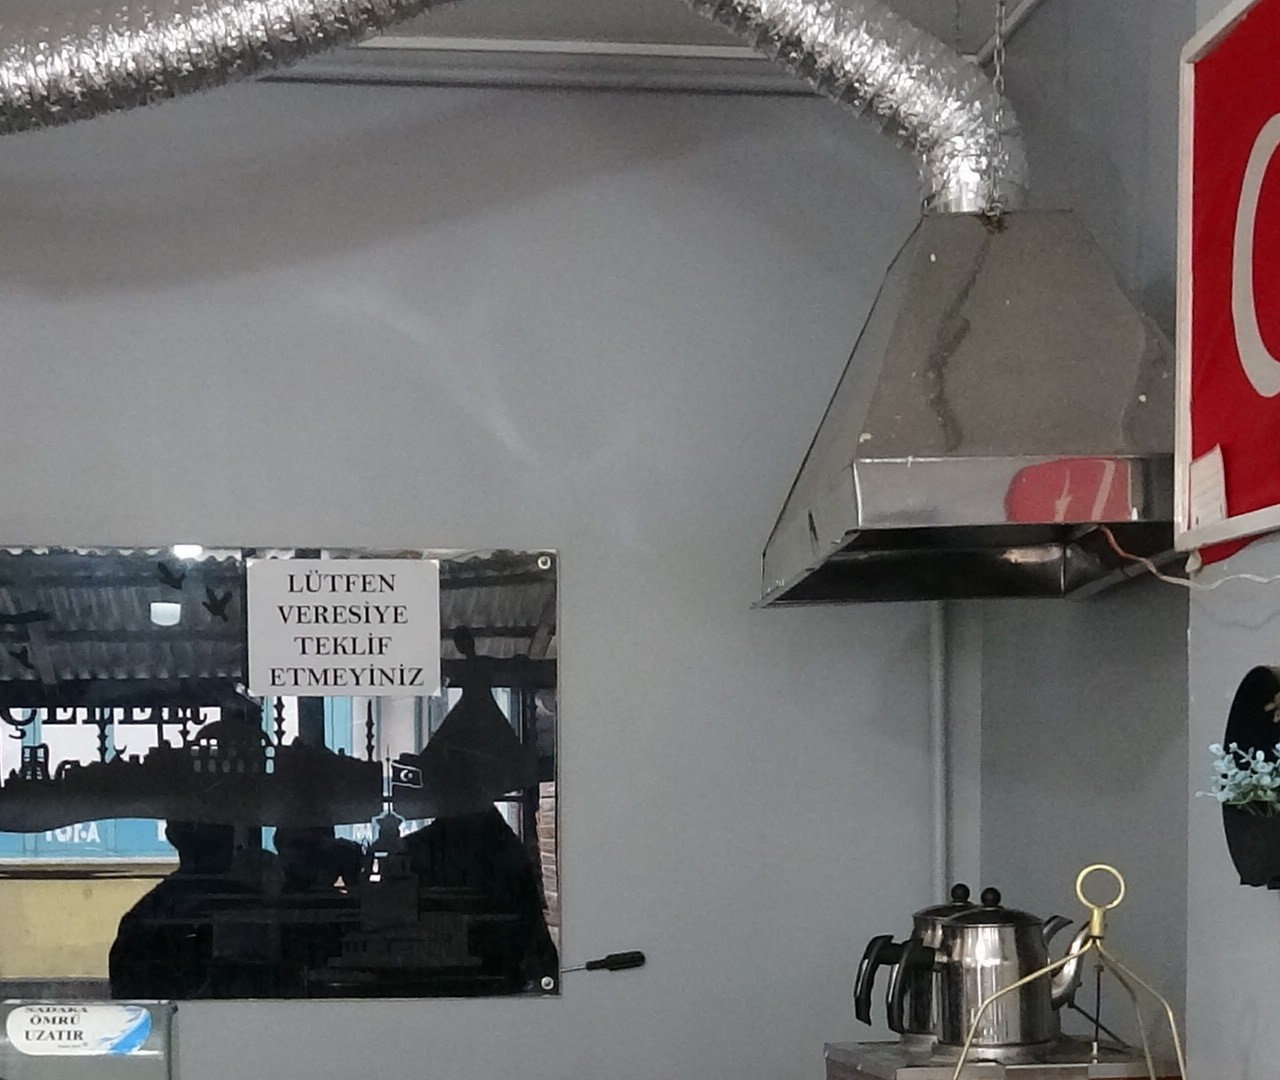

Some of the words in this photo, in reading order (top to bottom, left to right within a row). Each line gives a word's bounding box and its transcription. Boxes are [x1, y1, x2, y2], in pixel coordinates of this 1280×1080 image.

[288, 570, 396, 593] LÜTFEN
[278, 601, 408, 625] VERESİYE
[293, 633, 393, 656] TEKLİF
[270, 663, 424, 687] ETMEYİNİZ
[30, 1014, 80, 1025] ÖMRÜ
[24, 1030, 84, 1041] UZATIR
